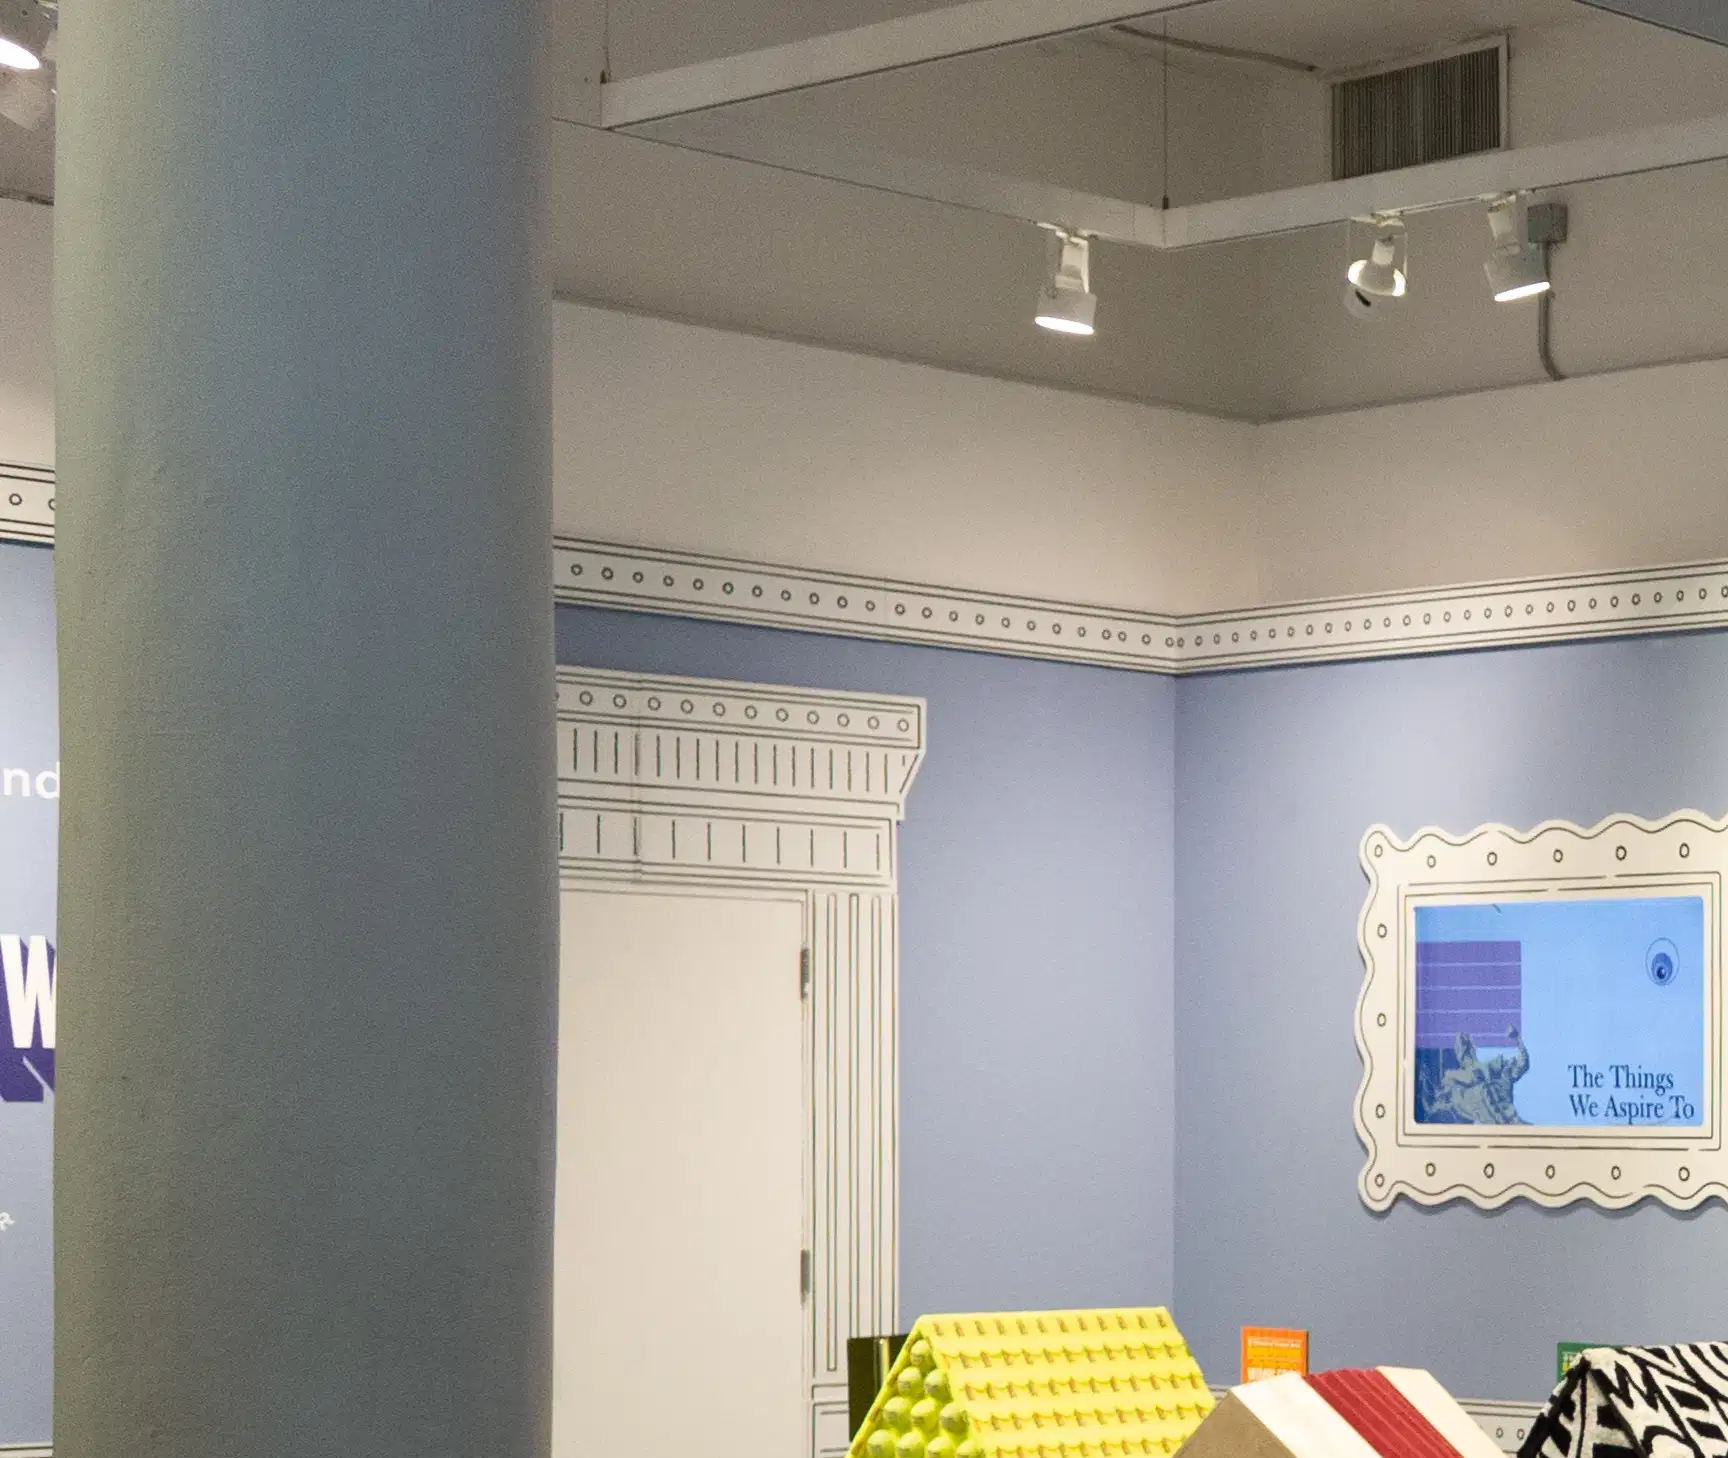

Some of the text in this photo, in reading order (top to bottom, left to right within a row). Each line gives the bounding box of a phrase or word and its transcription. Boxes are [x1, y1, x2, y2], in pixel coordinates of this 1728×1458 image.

[1567, 1064, 1674, 1097] The Things
[1569, 1094, 1695, 1125] We Aspire To
